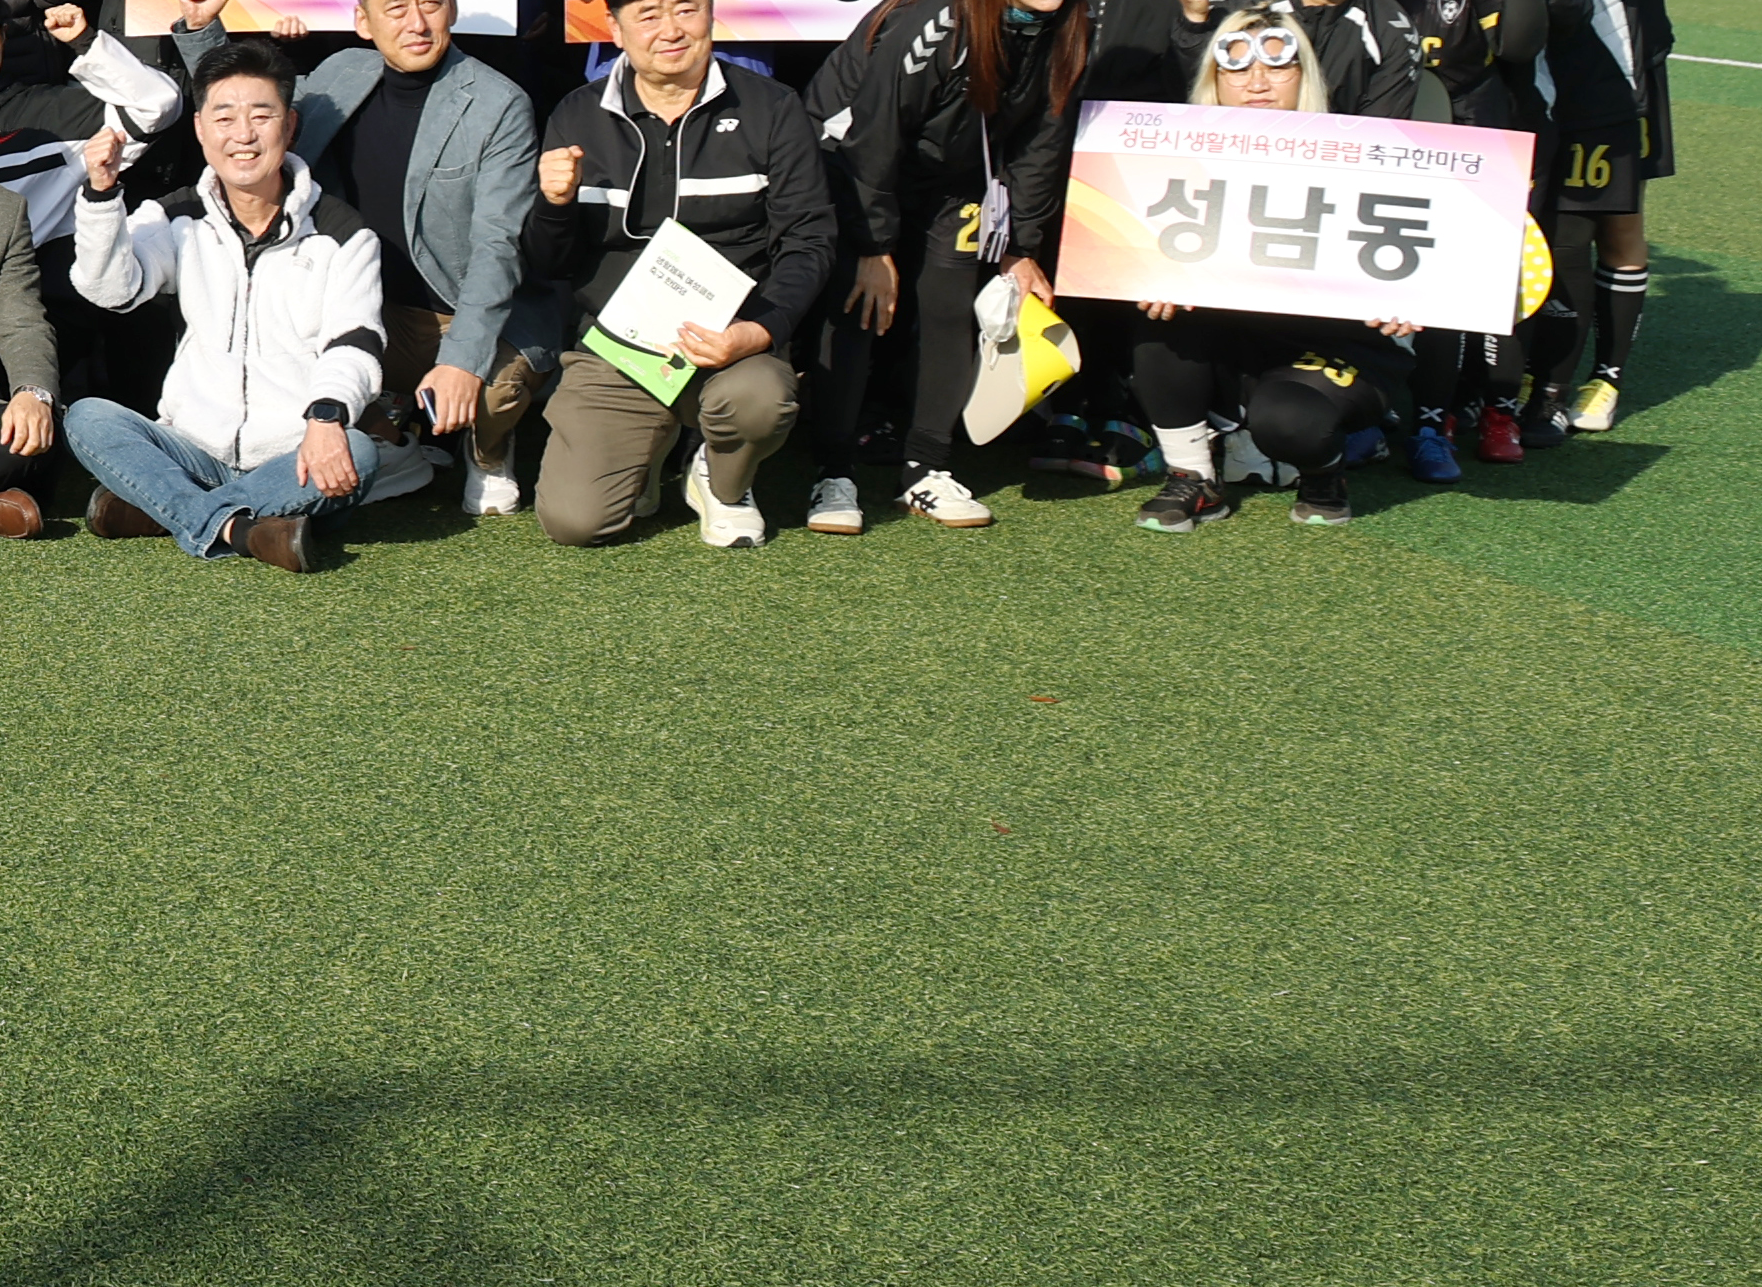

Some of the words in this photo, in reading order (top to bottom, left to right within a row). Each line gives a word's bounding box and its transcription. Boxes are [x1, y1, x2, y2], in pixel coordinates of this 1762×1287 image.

[1125, 112, 1162, 127] 2026
[1118, 127, 1178, 151] 성남시
[1183, 131, 1272, 156] 생활체육
[1274, 138, 1362, 162] 여성클럽
[1366, 145, 1483, 175] 축구한마당
[1564, 143, 1611, 188] 16
[1146, 178, 1436, 282] 성남동
